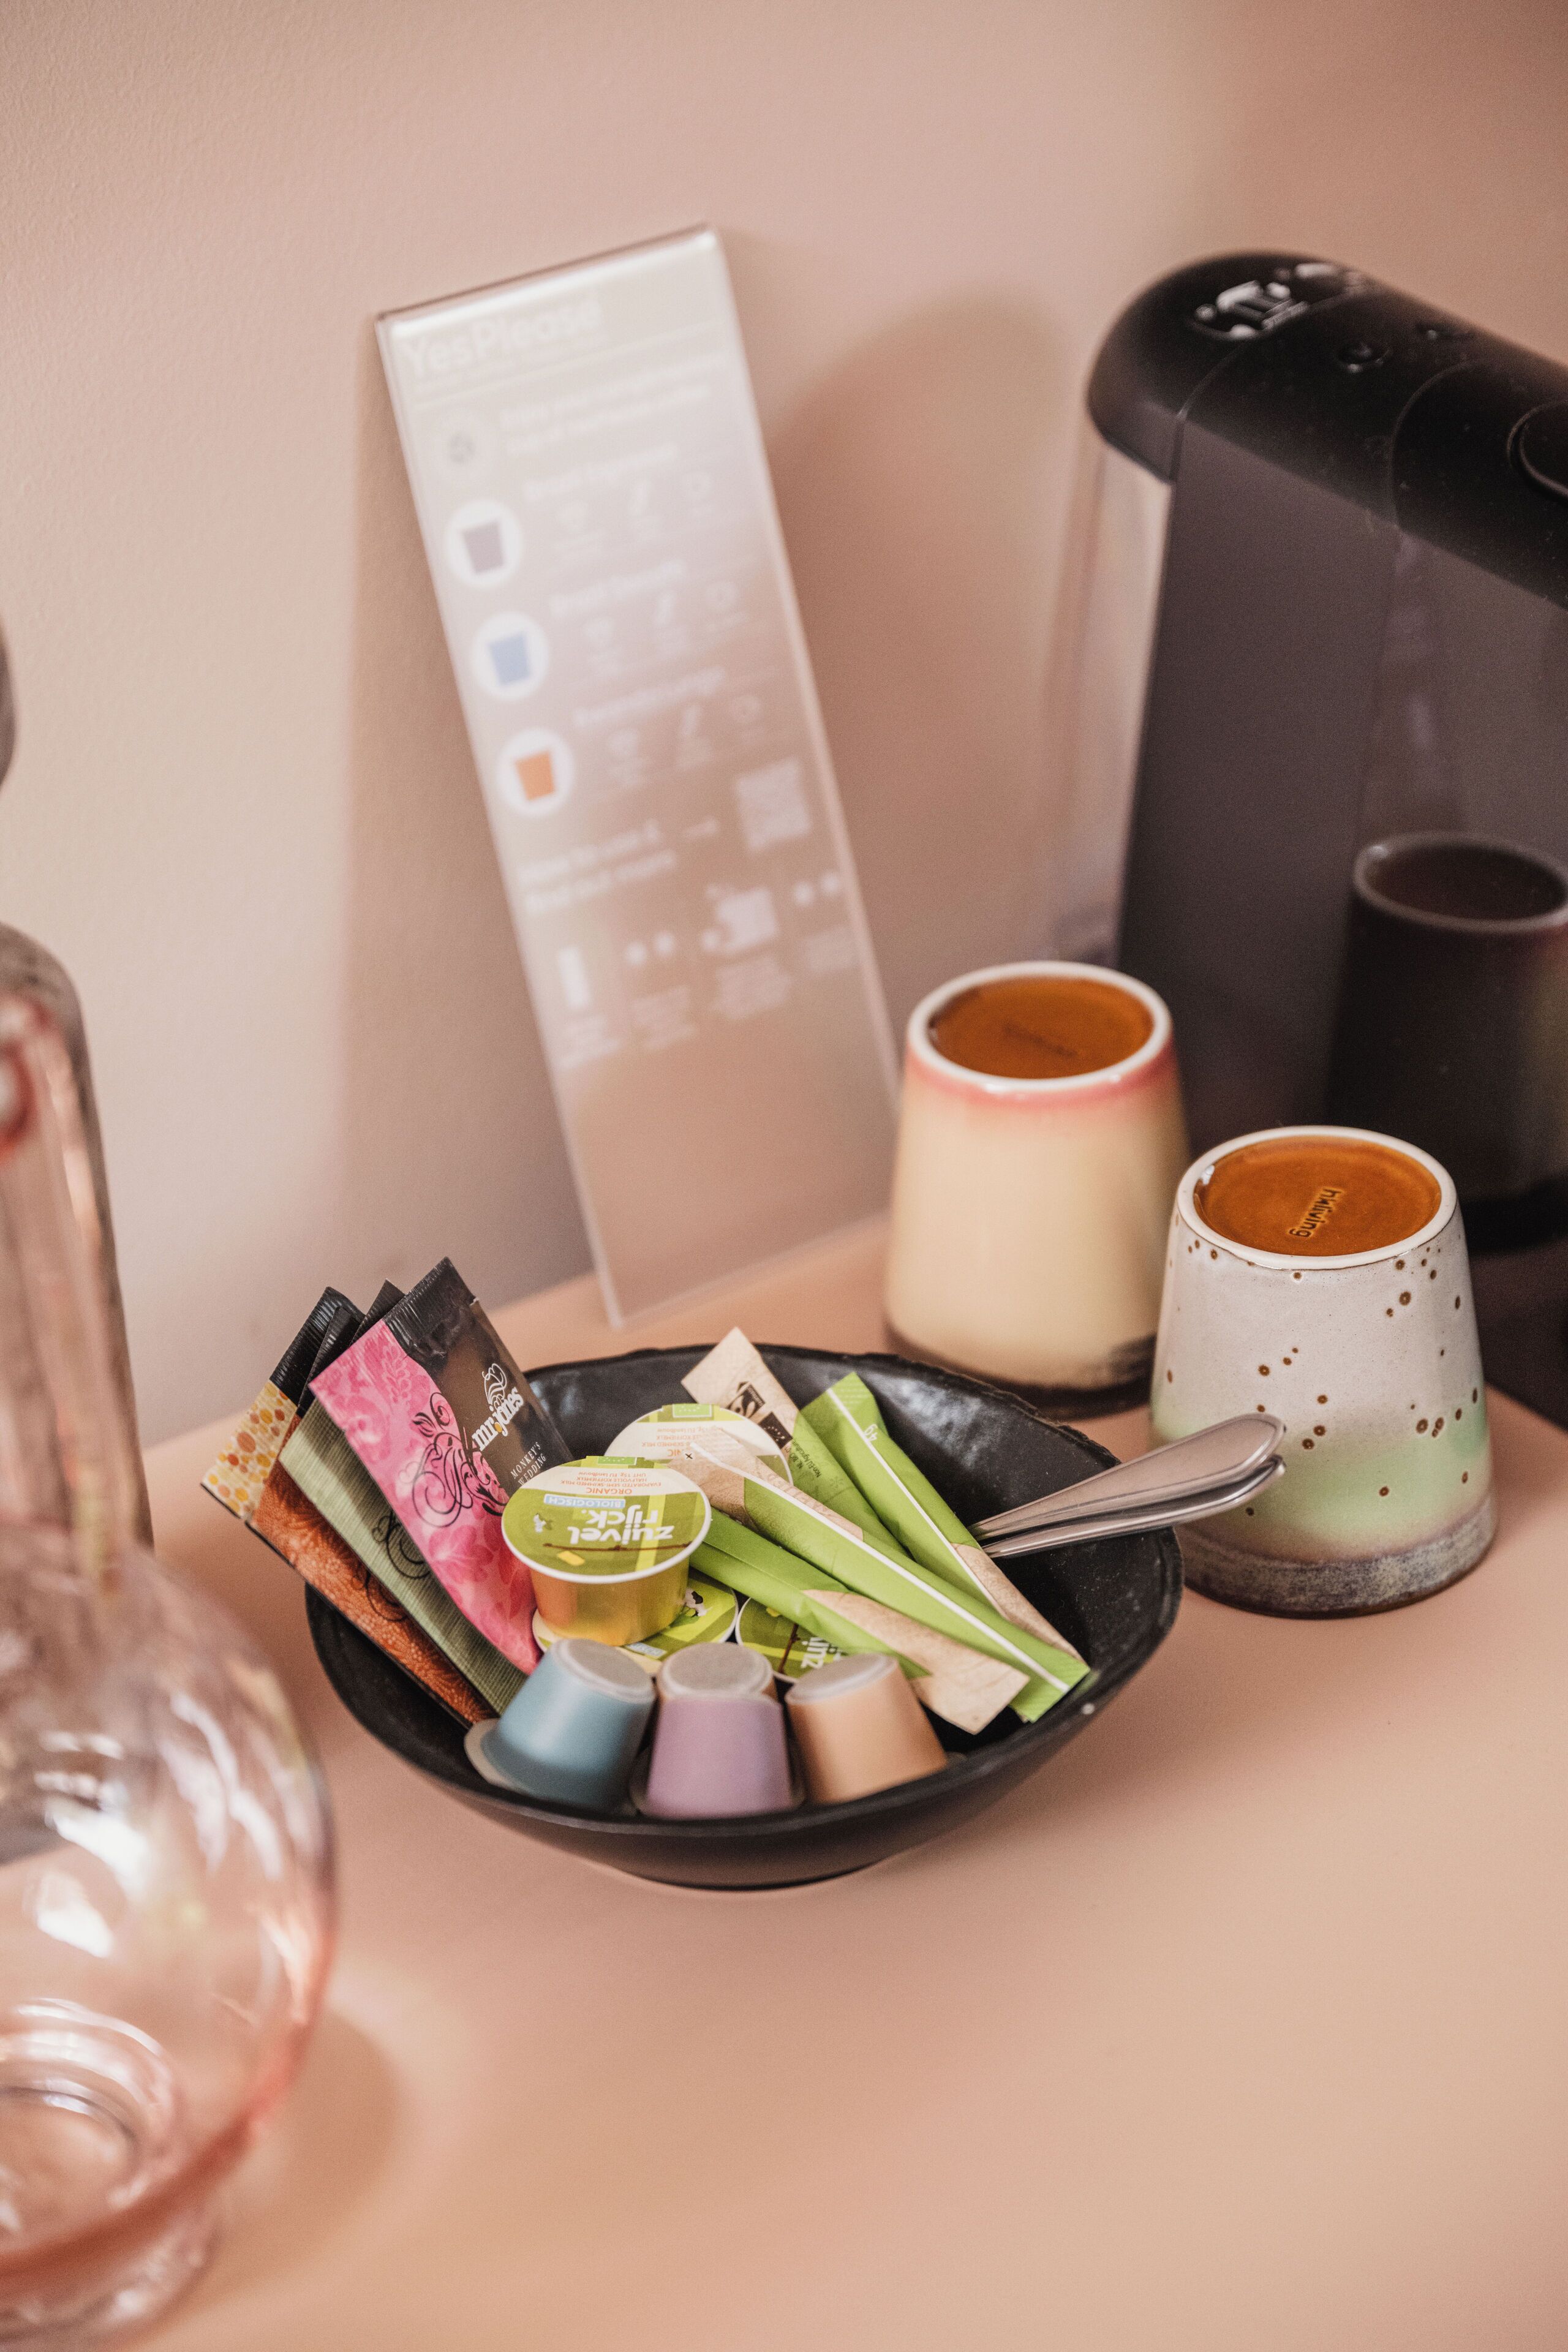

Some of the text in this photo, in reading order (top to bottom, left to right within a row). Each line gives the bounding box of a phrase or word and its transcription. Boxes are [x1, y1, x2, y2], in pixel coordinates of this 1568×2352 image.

[511, 1442, 541, 1479] MONKEY'S
[549, 1496, 621, 1508] BIOLOGISCH
[567, 1526, 674, 1545] zuivel
